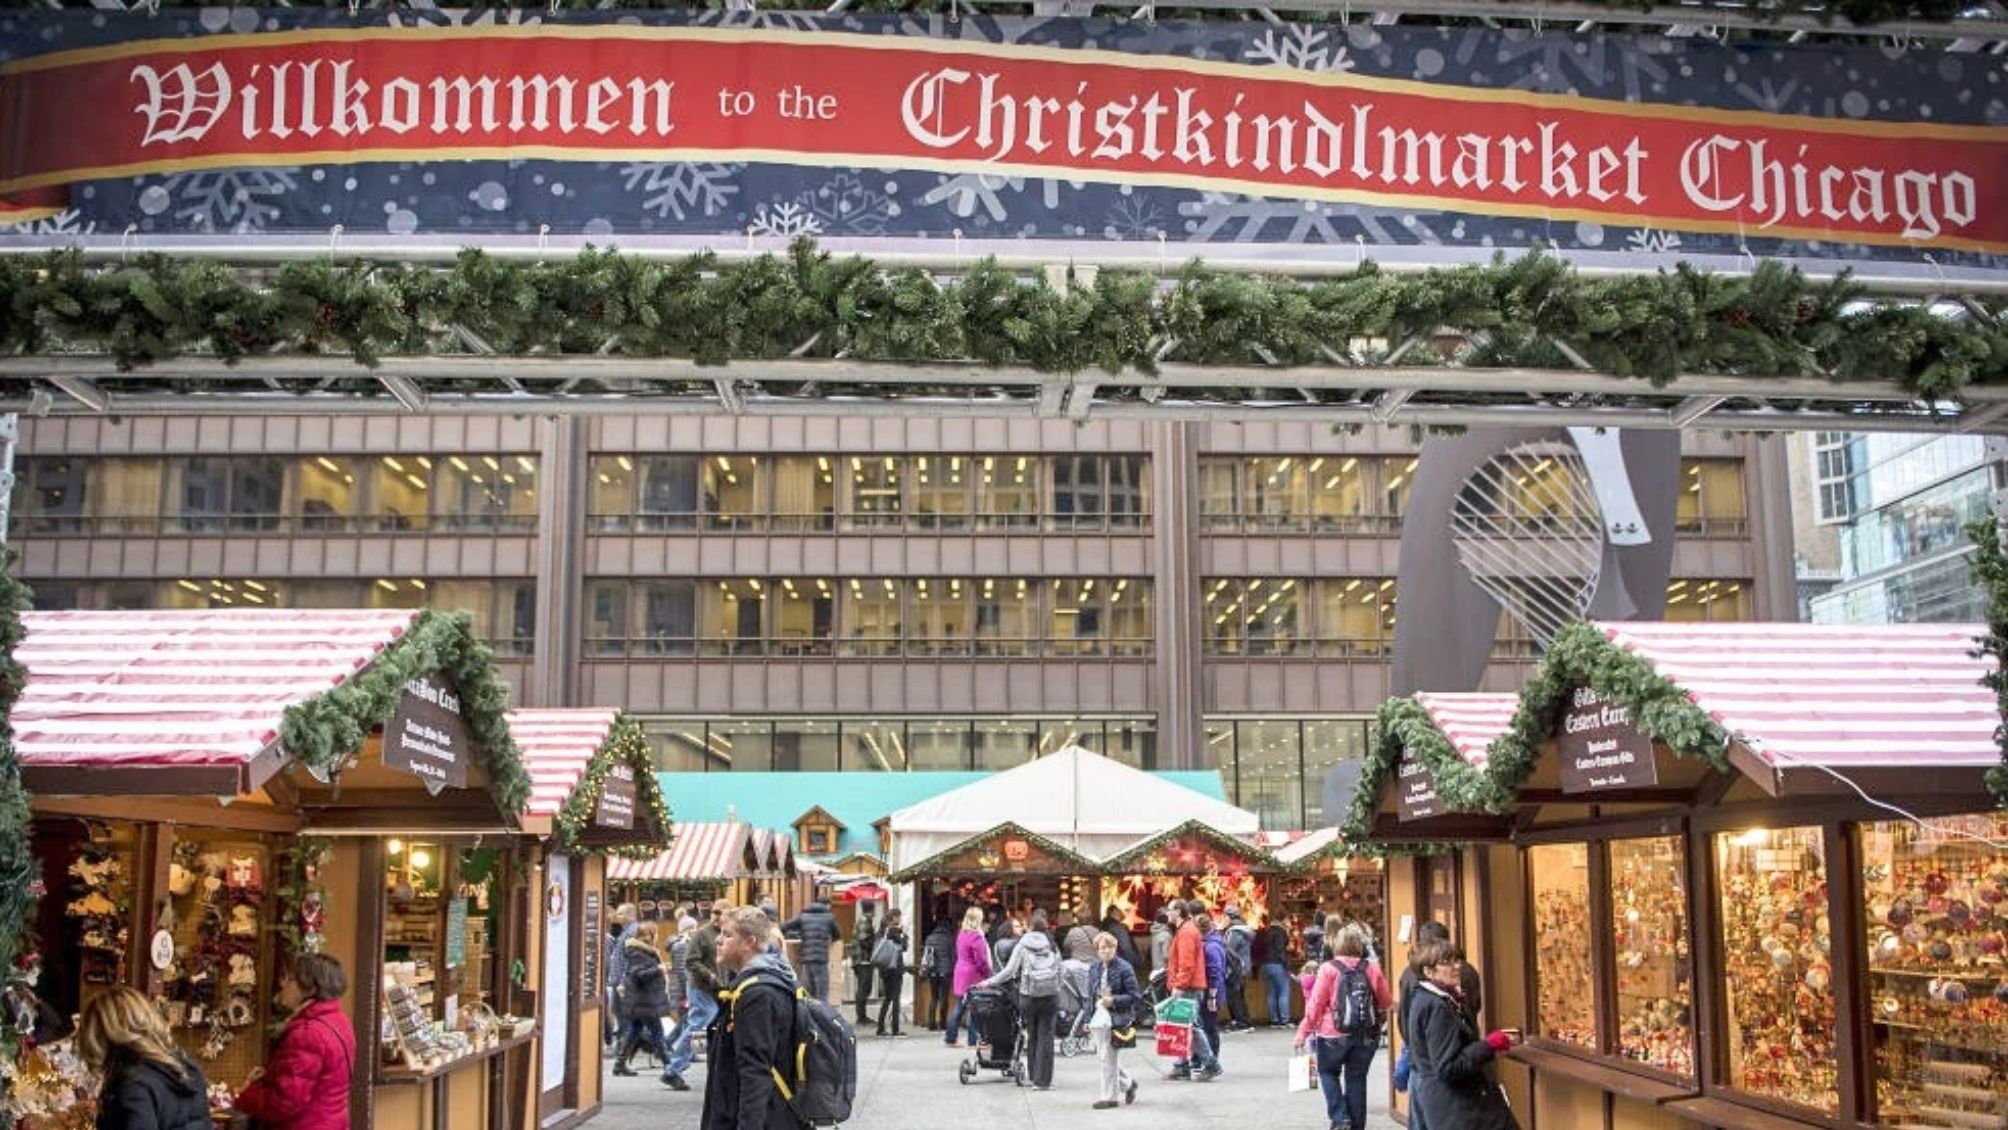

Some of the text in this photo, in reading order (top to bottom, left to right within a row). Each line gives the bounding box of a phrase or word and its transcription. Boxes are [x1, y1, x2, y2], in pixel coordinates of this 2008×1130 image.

[130, 58, 1976, 241] Willkommen to the Christkindlmarket Chicago
